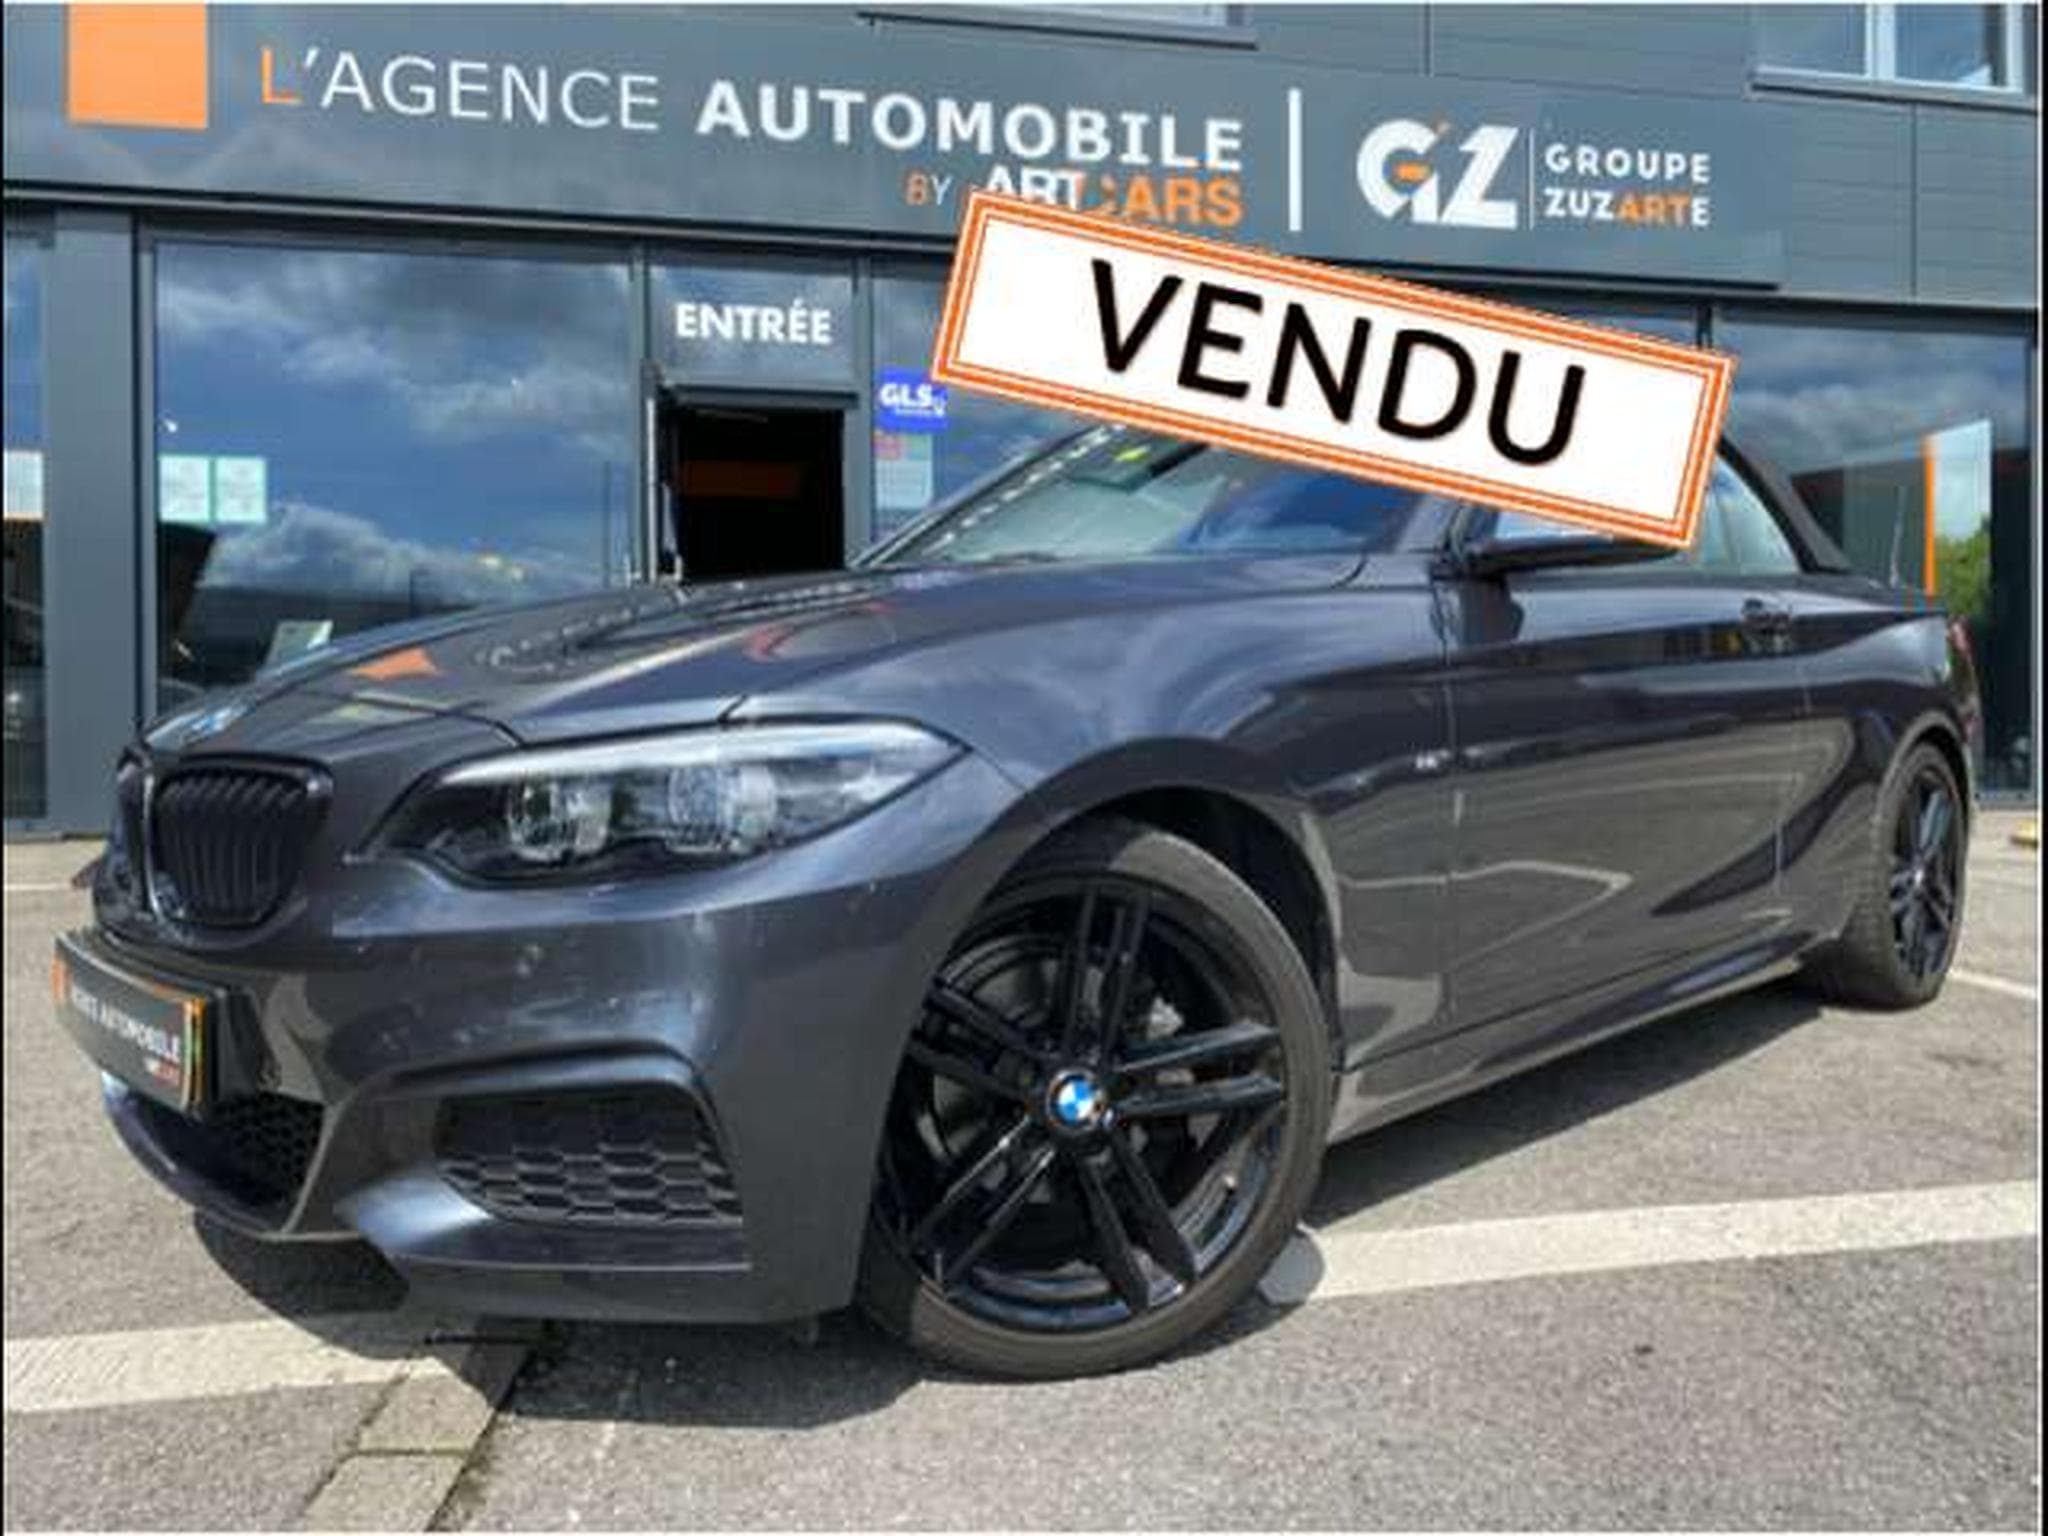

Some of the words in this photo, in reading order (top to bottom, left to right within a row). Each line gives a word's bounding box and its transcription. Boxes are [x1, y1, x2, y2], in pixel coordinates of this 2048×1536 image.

[261, 46, 659, 132] L'AGENCE
[695, 79, 1243, 172] AUTOMOBILE
[1544, 142, 1712, 184] GROUPE
[906, 171, 952, 207] BY
[1543, 187, 1712, 228] ZUZARTE
[674, 297, 833, 345] ENTRÉE
[880, 382, 933, 407] GLS
